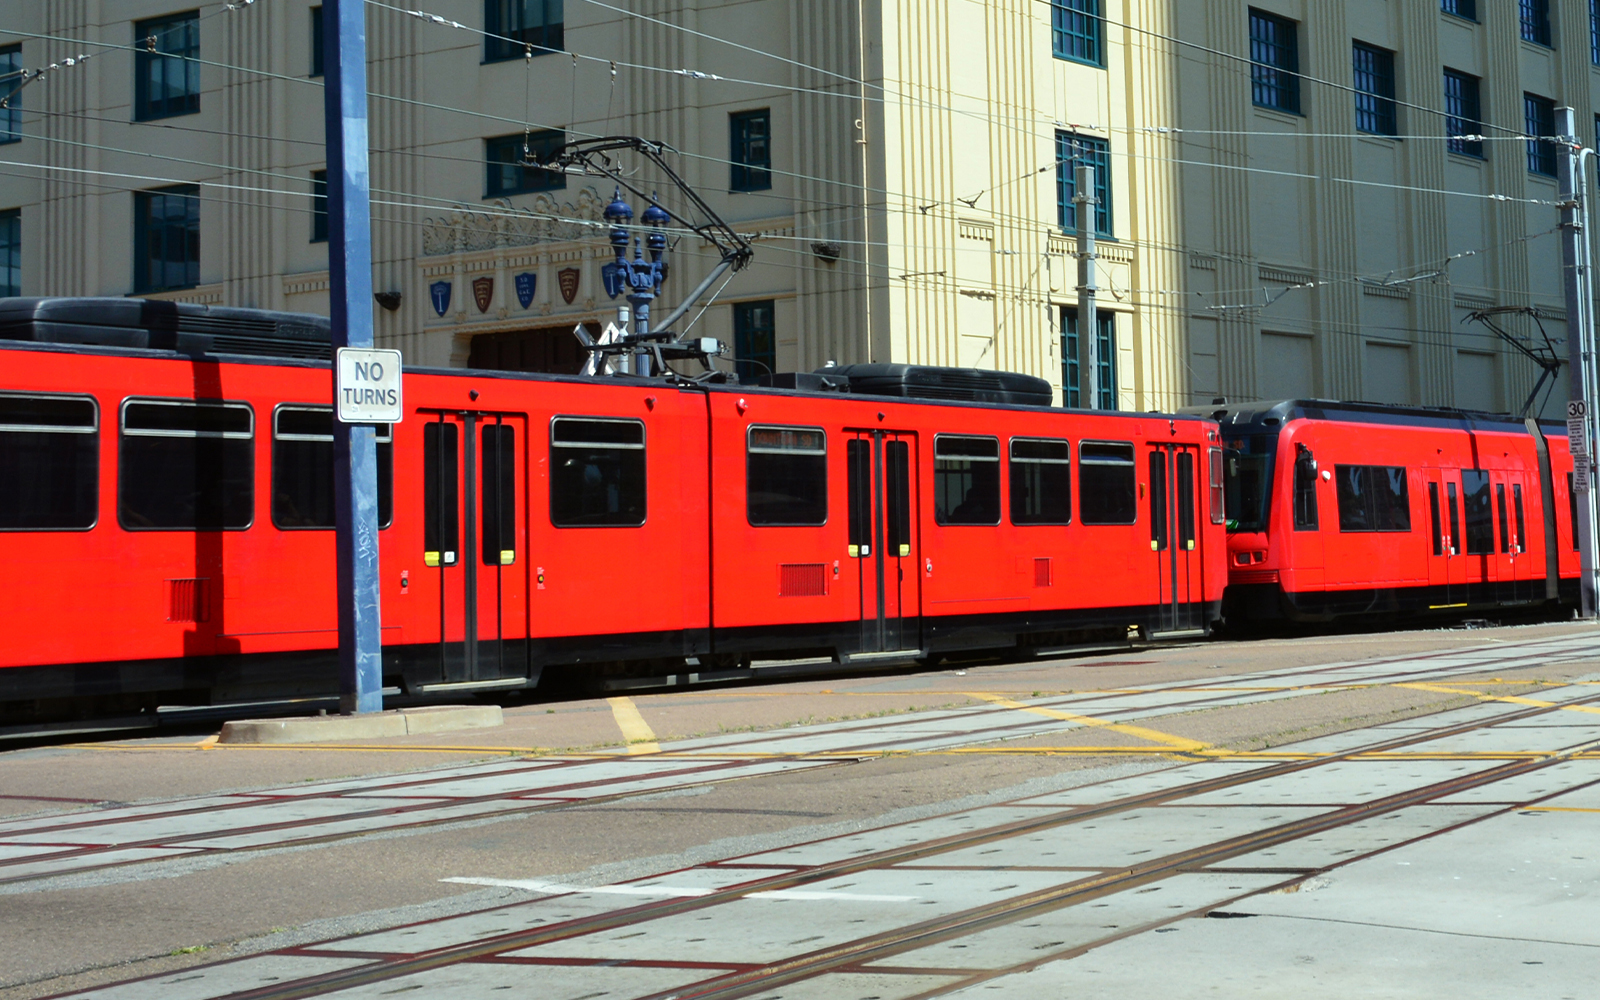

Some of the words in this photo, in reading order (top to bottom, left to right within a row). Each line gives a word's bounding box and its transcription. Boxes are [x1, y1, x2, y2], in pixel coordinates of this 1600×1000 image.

[355, 361, 384, 382] NO
[343, 388, 397, 406] TURNS
[1569, 402, 1585, 416] 30
